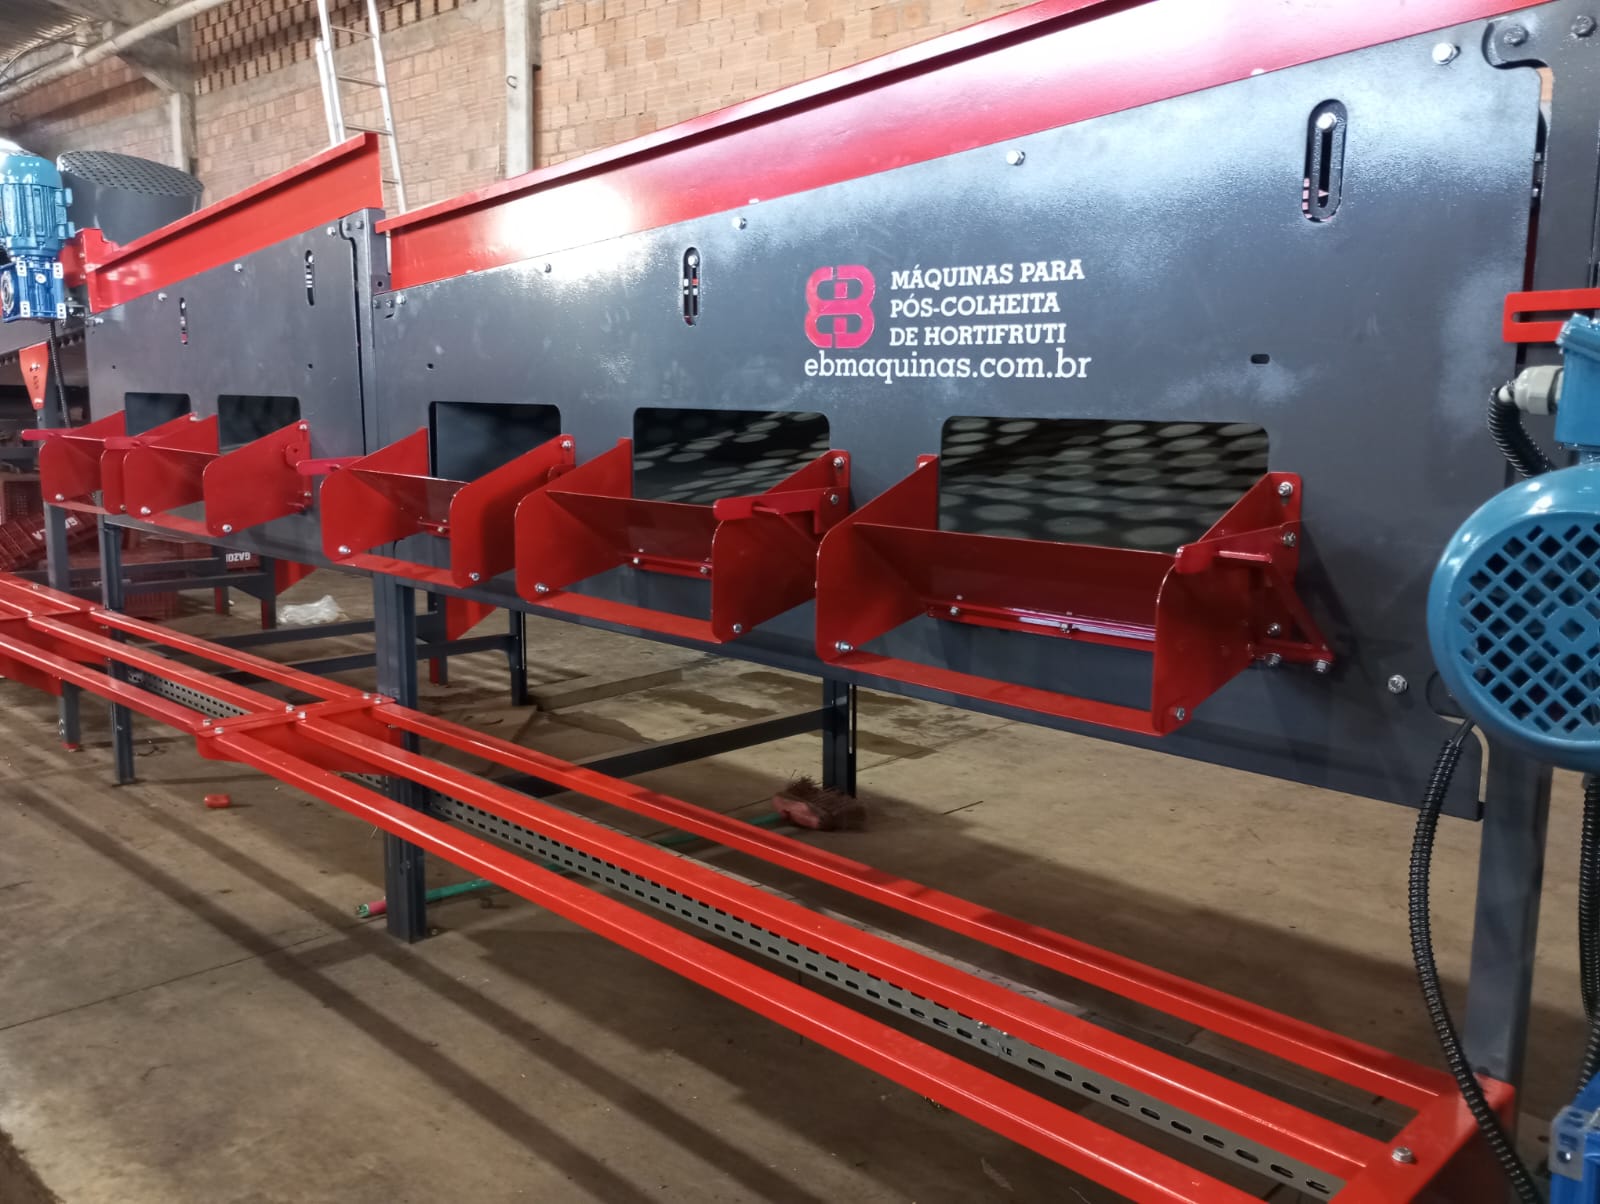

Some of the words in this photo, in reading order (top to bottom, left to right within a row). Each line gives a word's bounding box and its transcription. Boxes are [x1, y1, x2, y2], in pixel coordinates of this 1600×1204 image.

[890, 264, 1014, 290] MÁQUINAS
[1020, 259, 1085, 283] PARA
[890, 292, 1061, 318] PÓS-COLHEITA
[889, 327, 919, 346] DE
[923, 323, 1067, 346] HORTIFRUTI
[804, 347, 1092, 384] ebmaquinas.com.br
